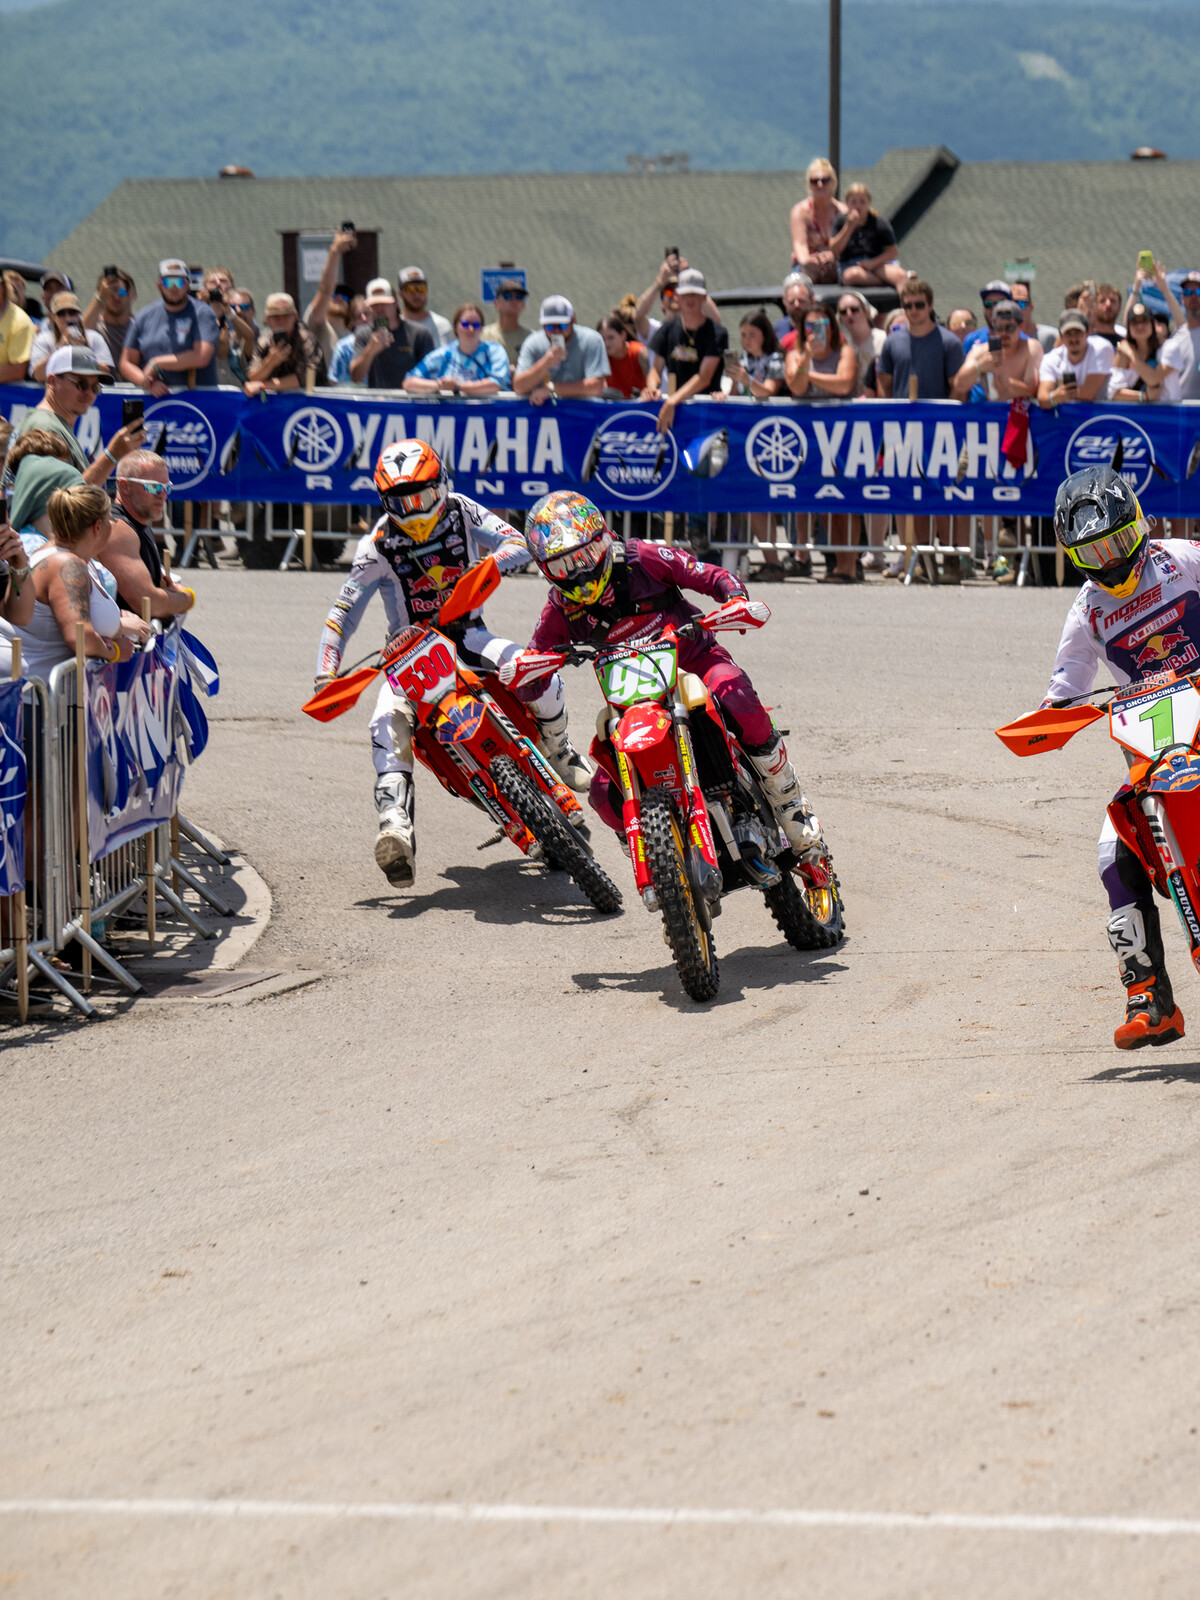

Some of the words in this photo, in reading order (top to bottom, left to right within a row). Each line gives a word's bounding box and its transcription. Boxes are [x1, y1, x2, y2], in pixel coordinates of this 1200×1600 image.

[812, 421, 1038, 478] YAMAHA
[306, 475, 550, 495] RANG
[769, 484, 1021, 501] RACING
[1104, 583, 1162, 629] MOOSE
[1124, 596, 1162, 623] OFFROAD
[397, 643, 456, 701] 530
[1169, 643, 1199, 671] Bull
[608, 651, 674, 704] 99
[1117, 713, 1127, 726] 1
[1139, 696, 1175, 751] 1
